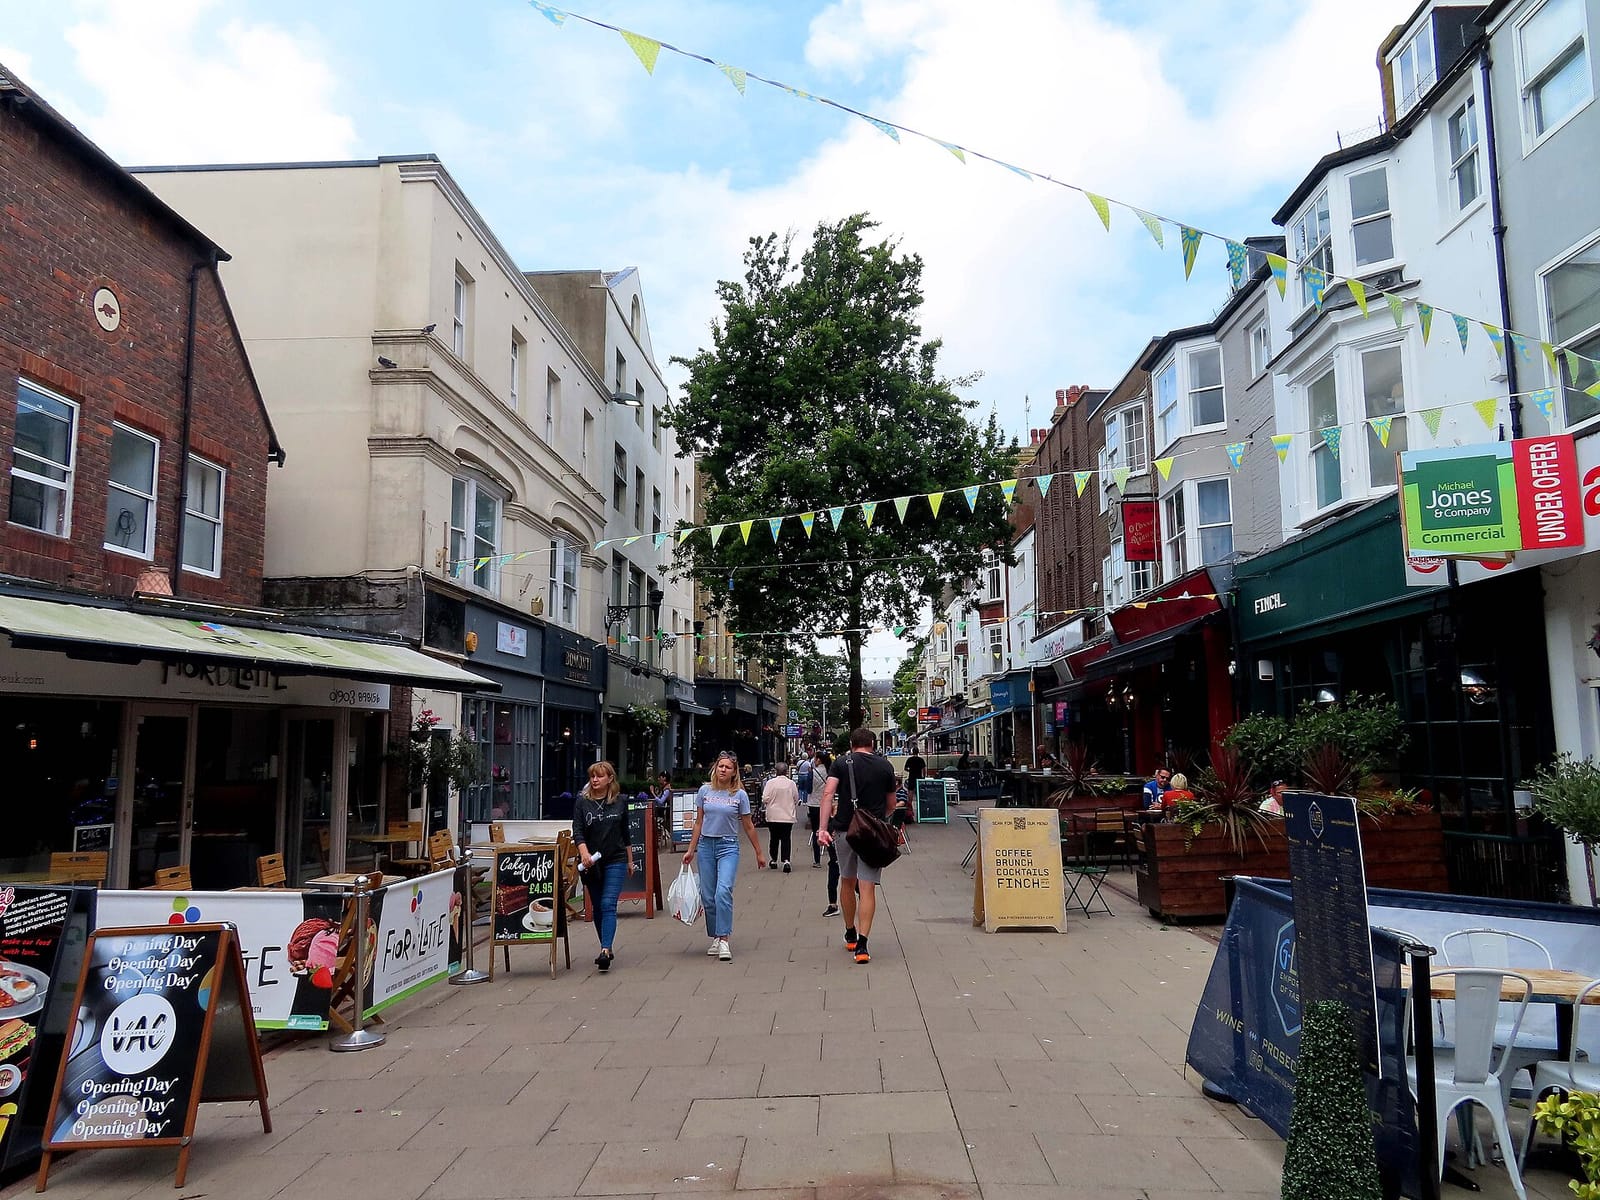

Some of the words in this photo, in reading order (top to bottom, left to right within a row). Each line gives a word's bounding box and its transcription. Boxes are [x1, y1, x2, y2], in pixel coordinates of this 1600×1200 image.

[1529, 441, 1560, 489] OFFER
[1438, 480, 1475, 492] Michael
[1426, 489, 1493, 509] Jones
[1434, 509, 1443, 518] &
[1444, 506, 1491, 518] Company
[1533, 491, 1567, 543] UNDER
[1422, 527, 1506, 544] Commercial
[995, 849, 1032, 857] COFFEE
[995, 858, 1033, 866] BRUNCH
[500, 856, 524, 871] Cake
[996, 868, 1049, 876] COCKTAILS
[529, 882, 553, 894] £4.95
[11, 897, 39, 909] Breakfast
[37, 896, 67, 908] Homemade
[51, 902, 68, 911] Lunch
[5, 928, 25, 938] freshly
[26, 920, 51, 932] prepared
[23, 918, 33, 926] and
[113, 937, 173, 955] pning
[173, 935, 206, 952] Day
[108, 954, 169, 974] Opening
[169, 953, 202, 971] Day
[104, 974, 166, 994] Opening
[166, 972, 199, 990] Day
[1279, 984, 1288, 993] OF
[1288, 988, 1300, 1002] TAS
[1216, 1008, 1244, 1034] WINE
[112, 1013, 168, 1053] VAC
[1261, 1038, 1300, 1073] PROSEC
[81, 1077, 144, 1098] Opening
[144, 1076, 179, 1095] Day
[77, 1098, 140, 1119] Opening
[140, 1097, 175, 1115] Day
[72, 1120, 136, 1140] Opening
[136, 1118, 171, 1137] Day
